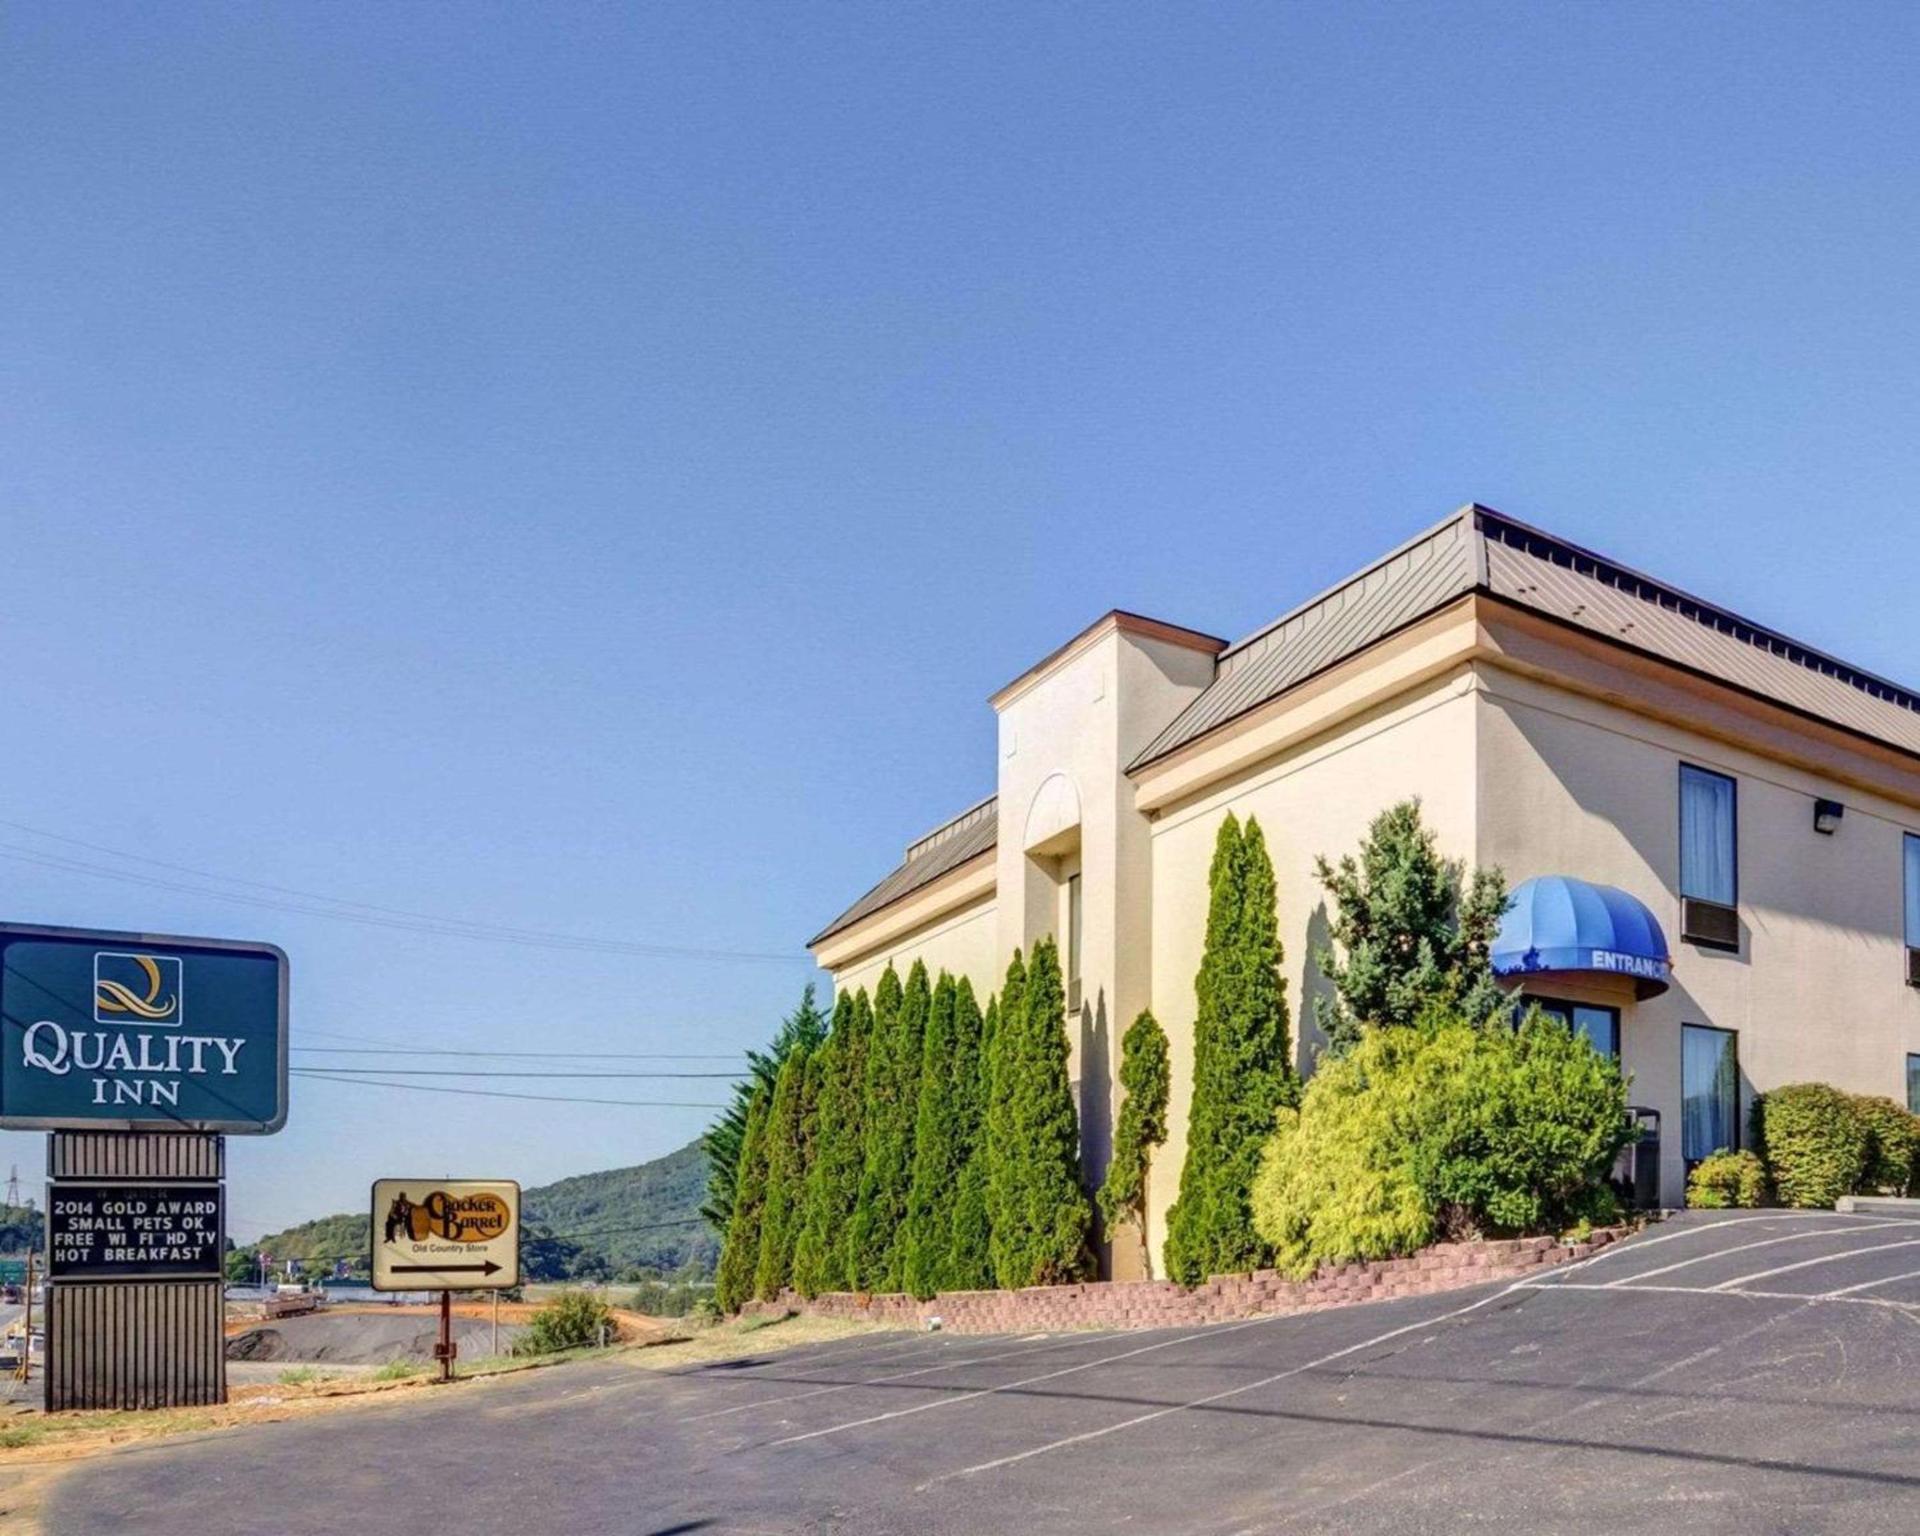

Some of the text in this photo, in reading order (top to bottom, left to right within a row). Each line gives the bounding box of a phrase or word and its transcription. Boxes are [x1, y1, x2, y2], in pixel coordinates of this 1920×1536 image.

[23, 1021, 246, 1075] QUALITY
[92, 1078, 180, 1106] INN
[54, 1201, 216, 1215] 2014 GOLD AWARD
[68, 1217, 204, 1230] SMALL PETS OK
[54, 1231, 216, 1246] FREE WI FI HD TV
[55, 1247, 202, 1262] HOT BREAKFAST
[412, 1243, 488, 1255] Old Country Store
